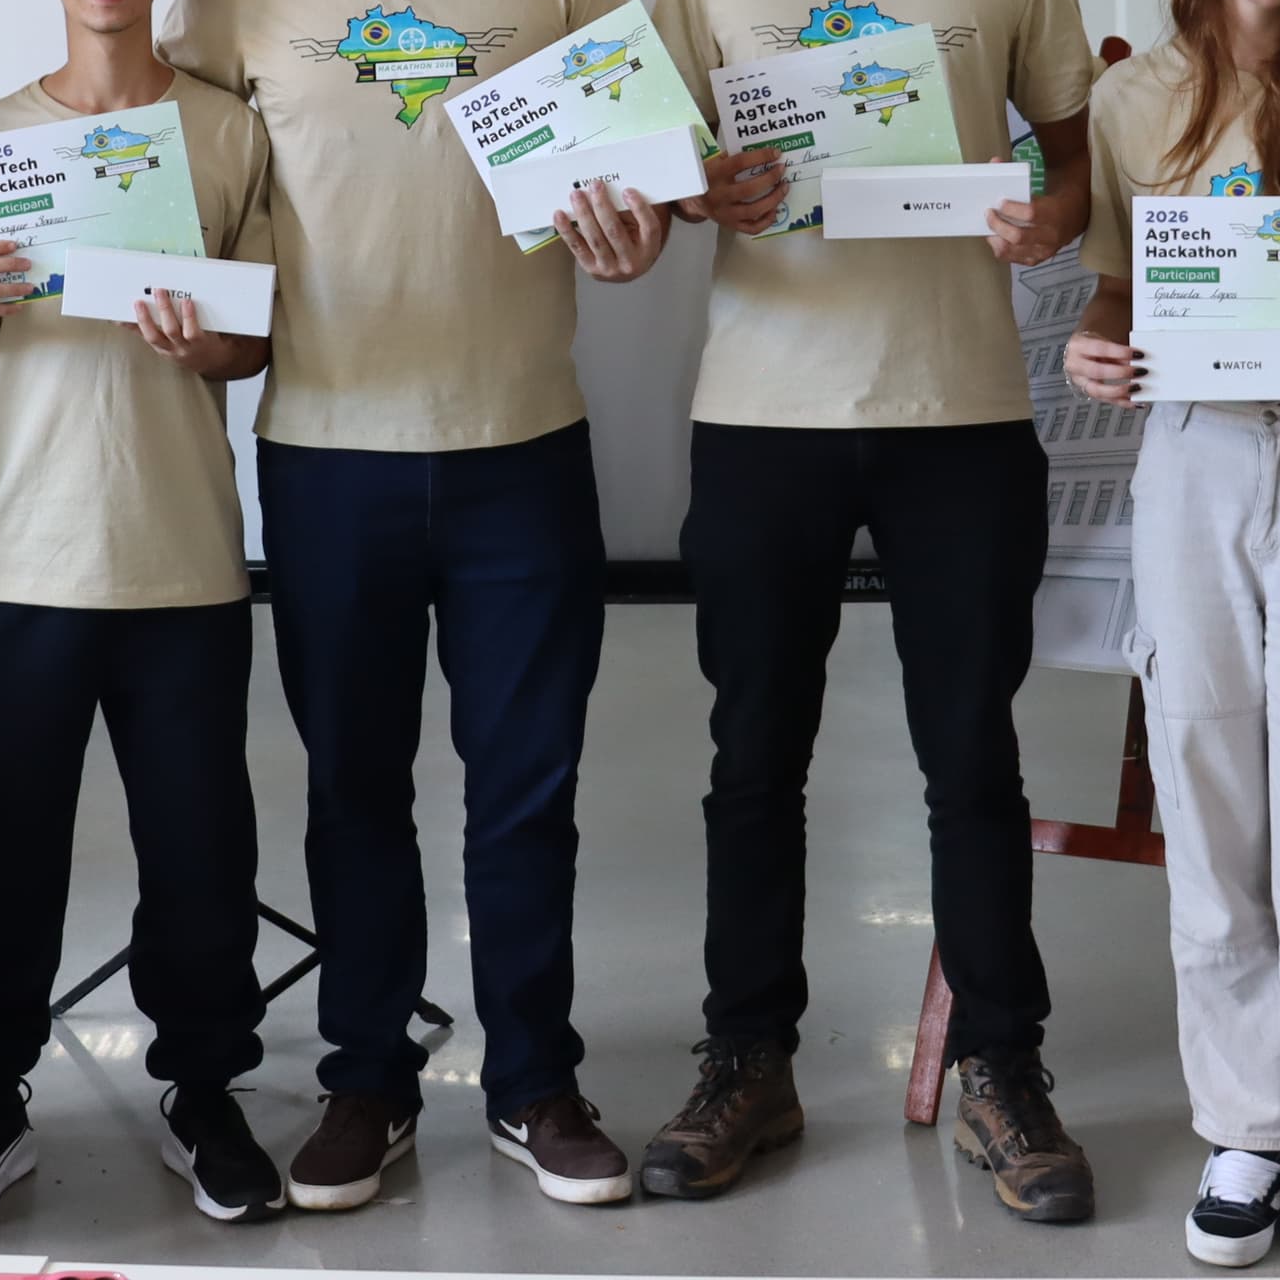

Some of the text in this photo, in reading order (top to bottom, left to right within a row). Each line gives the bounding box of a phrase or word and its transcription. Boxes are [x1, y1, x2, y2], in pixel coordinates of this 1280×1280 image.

[432, 40, 456, 49] UFV
[378, 62, 432, 72] HACKATHON
[729, 86, 772, 105] 2026
[461, 89, 501, 118] 2026
[734, 97, 797, 124] AgTech
[471, 94, 528, 133] AgTech
[477, 99, 558, 149] Hackathon
[737, 109, 826, 139] Hackathon
[492, 128, 551, 166] Participant
[582, 172, 620, 188] WTCH
[913, 201, 951, 210] WATCH
[1145, 210, 1189, 223] 2026
[1145, 228, 1211, 243] AgTech
[1145, 245, 1237, 258] Hackathon
[1150, 269, 1216, 282] Participant
[1223, 360, 1262, 370] WATCH
